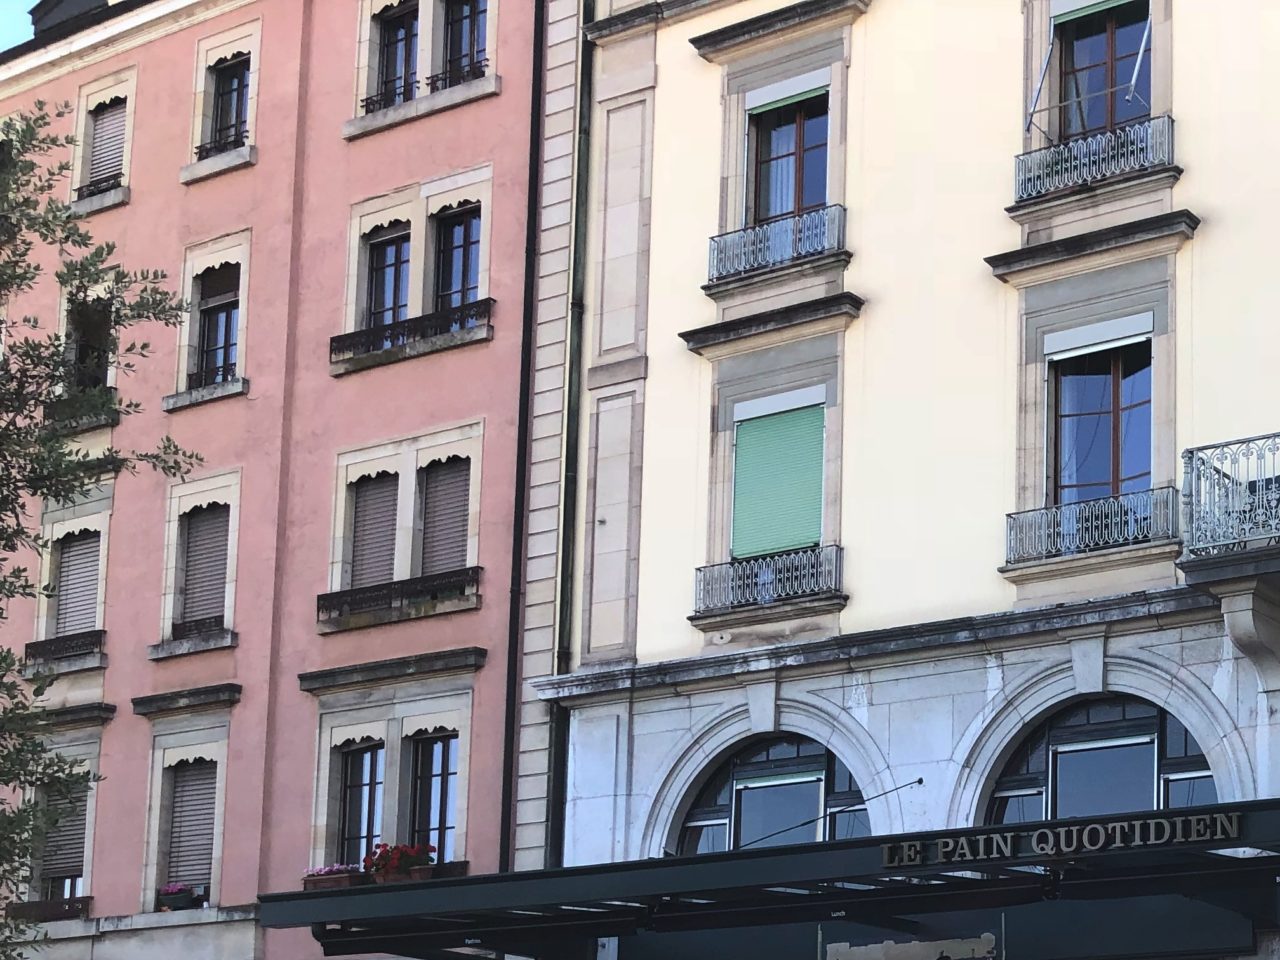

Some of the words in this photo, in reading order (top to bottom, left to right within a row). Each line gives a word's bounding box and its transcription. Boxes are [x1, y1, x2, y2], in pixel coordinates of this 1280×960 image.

[881, 840, 924, 869] LE
[935, 832, 1015, 863] PAIN
[1031, 812, 1243, 856] QUOTIDIEN
